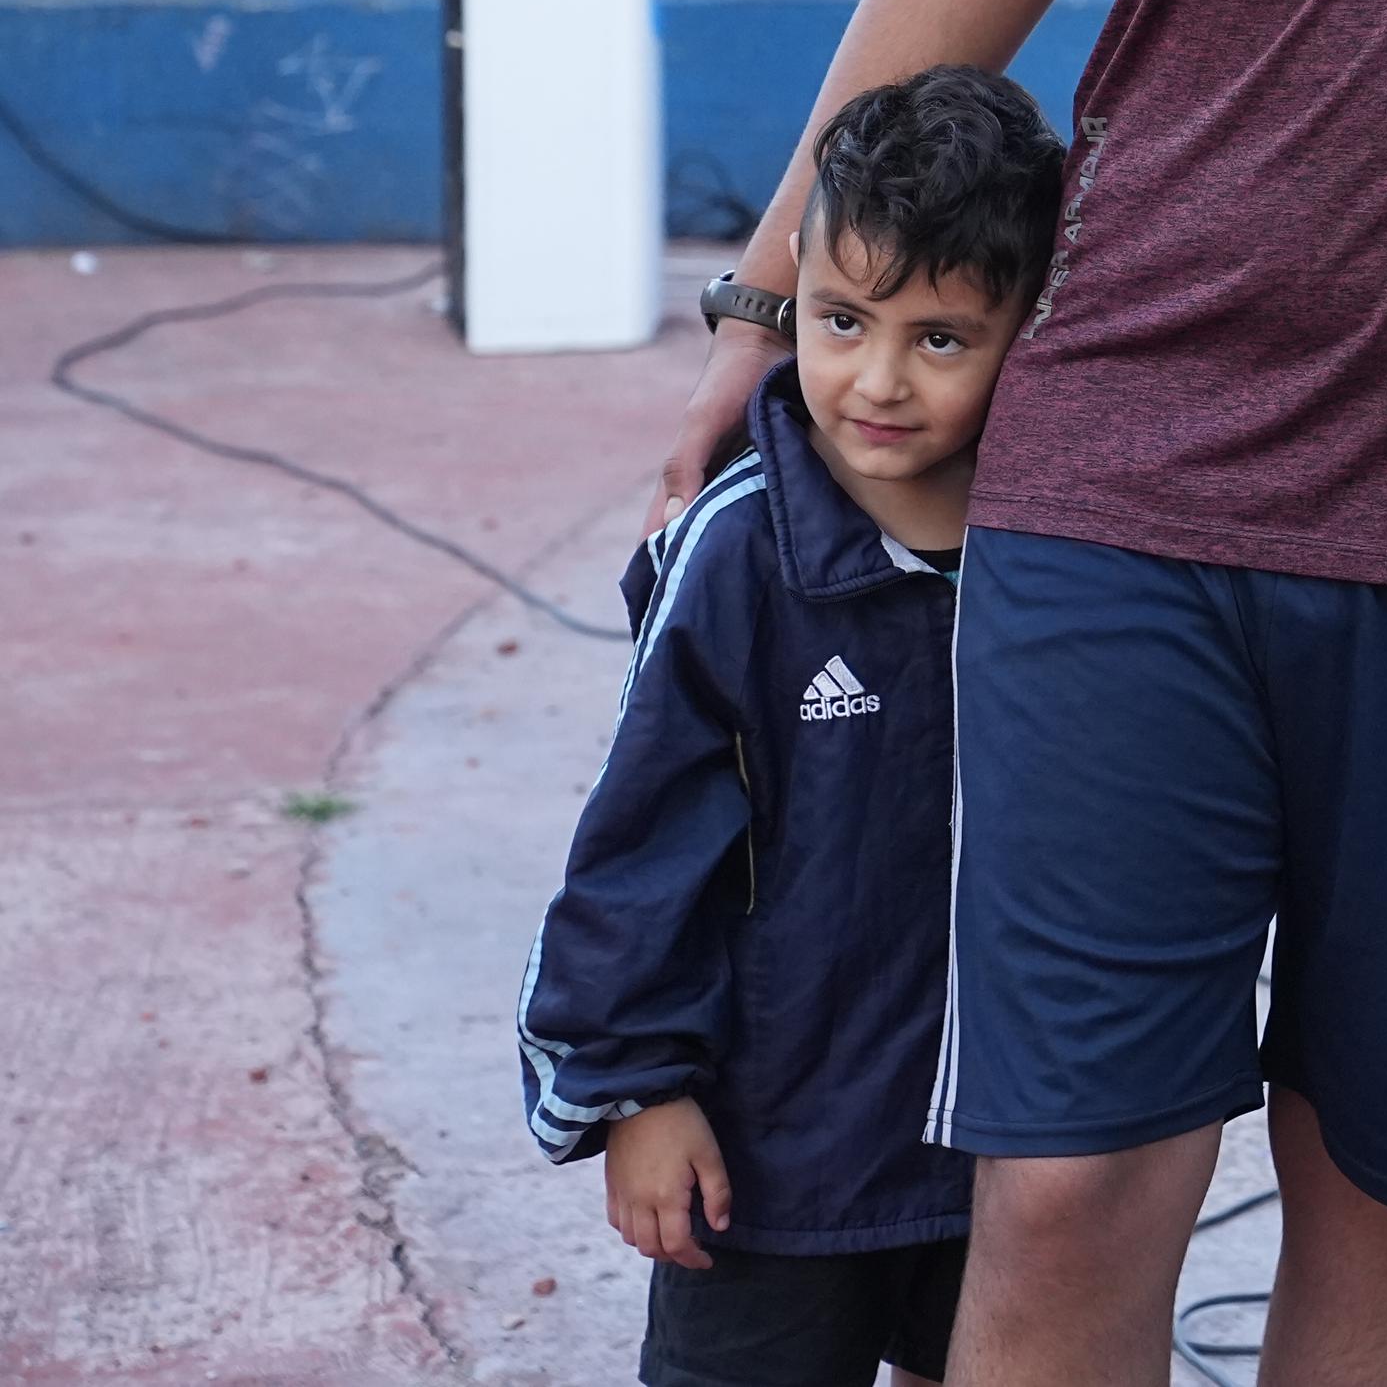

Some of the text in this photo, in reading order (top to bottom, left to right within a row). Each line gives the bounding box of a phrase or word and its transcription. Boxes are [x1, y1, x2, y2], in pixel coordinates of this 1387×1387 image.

[1023, 116, 1108, 340] UNDER ARMOUR
[800, 694, 880, 721] adidas
